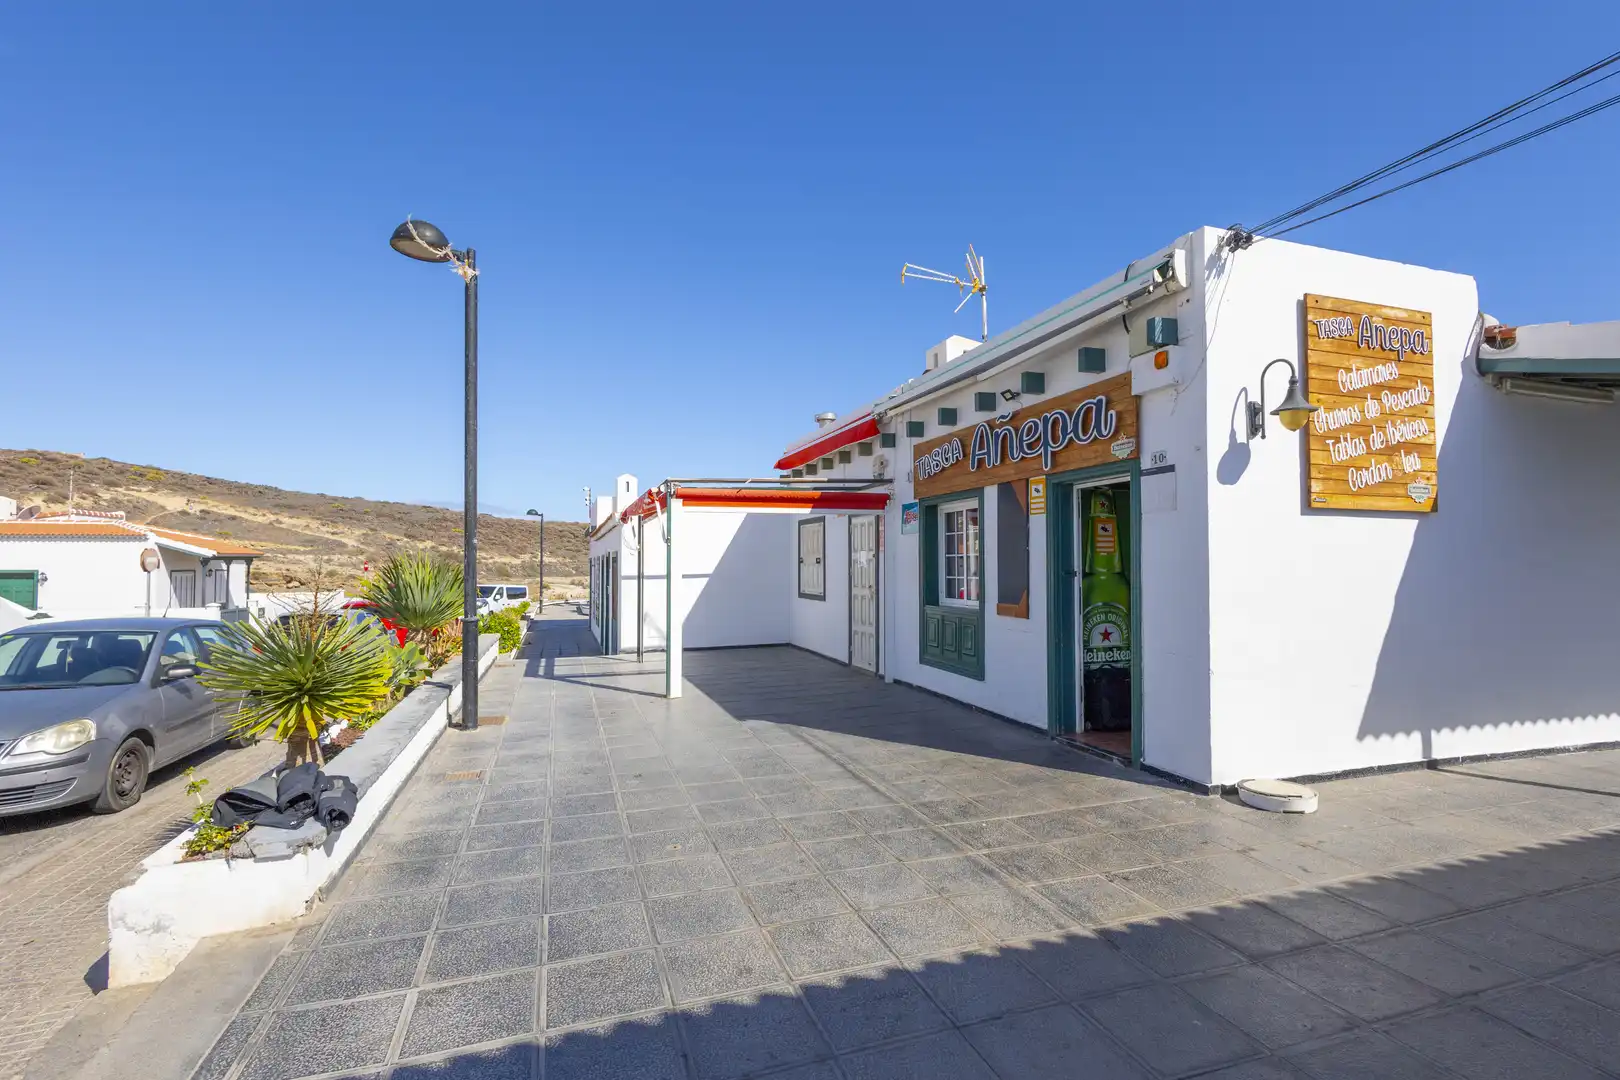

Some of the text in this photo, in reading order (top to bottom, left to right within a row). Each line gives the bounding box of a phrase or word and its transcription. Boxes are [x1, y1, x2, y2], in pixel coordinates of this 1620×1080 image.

[1313, 316, 1354, 339] TASCA
[1338, 361, 1399, 393] Calamares
[1314, 379, 1430, 434] Churros de Pescado
[915, 395, 1116, 480] TASCA Añepa
[1325, 418, 1428, 464] Tablas de Ibéricos
[1348, 458, 1392, 492] Cordon
[1084, 613, 1106, 640] HEINEKEN
